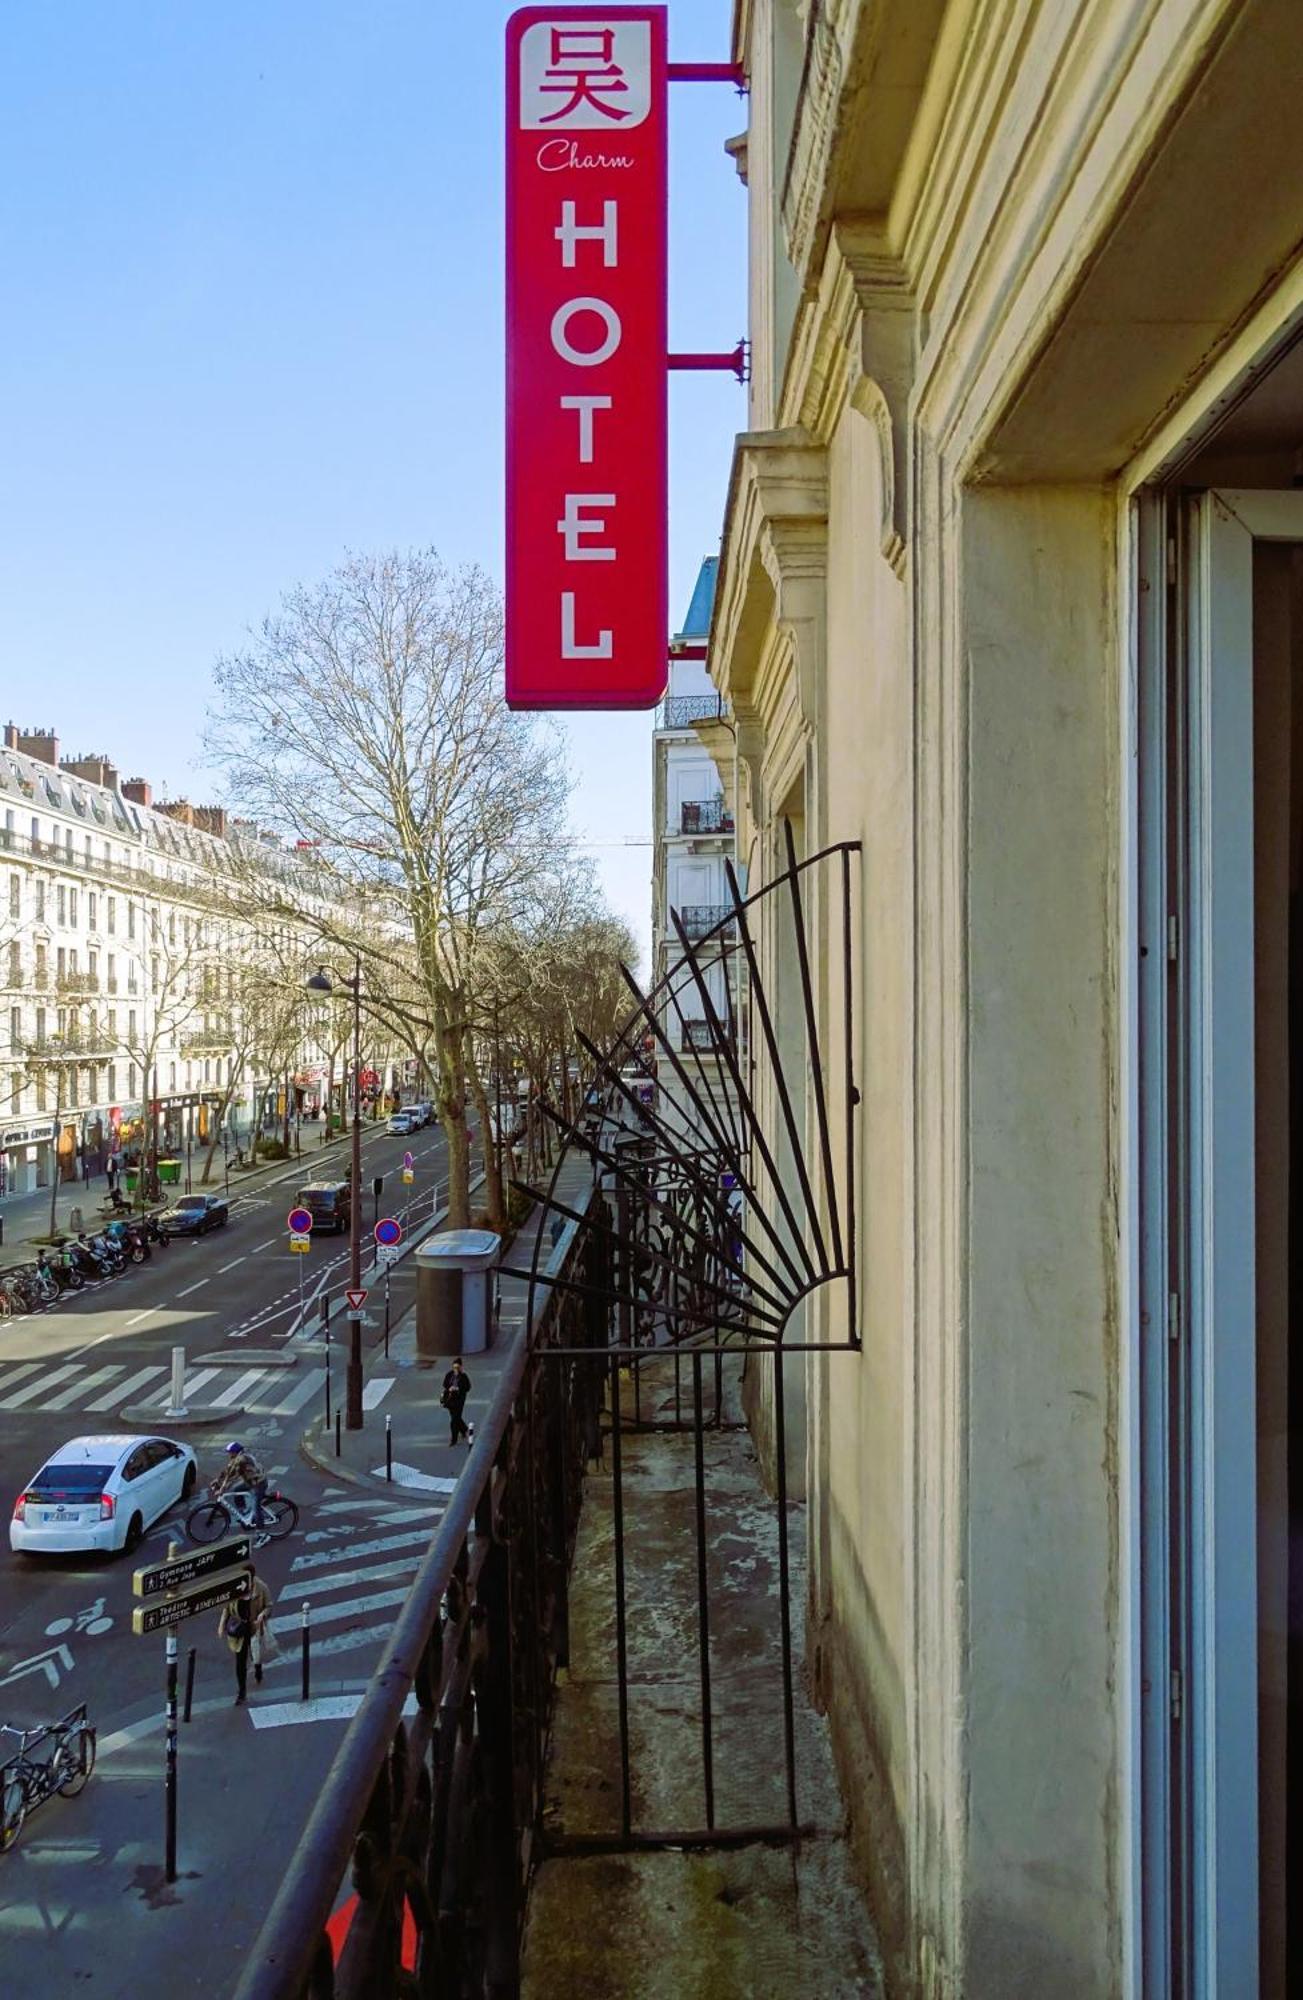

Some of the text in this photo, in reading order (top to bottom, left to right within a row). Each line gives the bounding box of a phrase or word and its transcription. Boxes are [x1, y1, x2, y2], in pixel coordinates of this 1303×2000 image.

[537, 139, 634, 171] Charm
[551, 200, 622, 659] HOTEL
[159, 1564, 193, 1580] Gymnase
